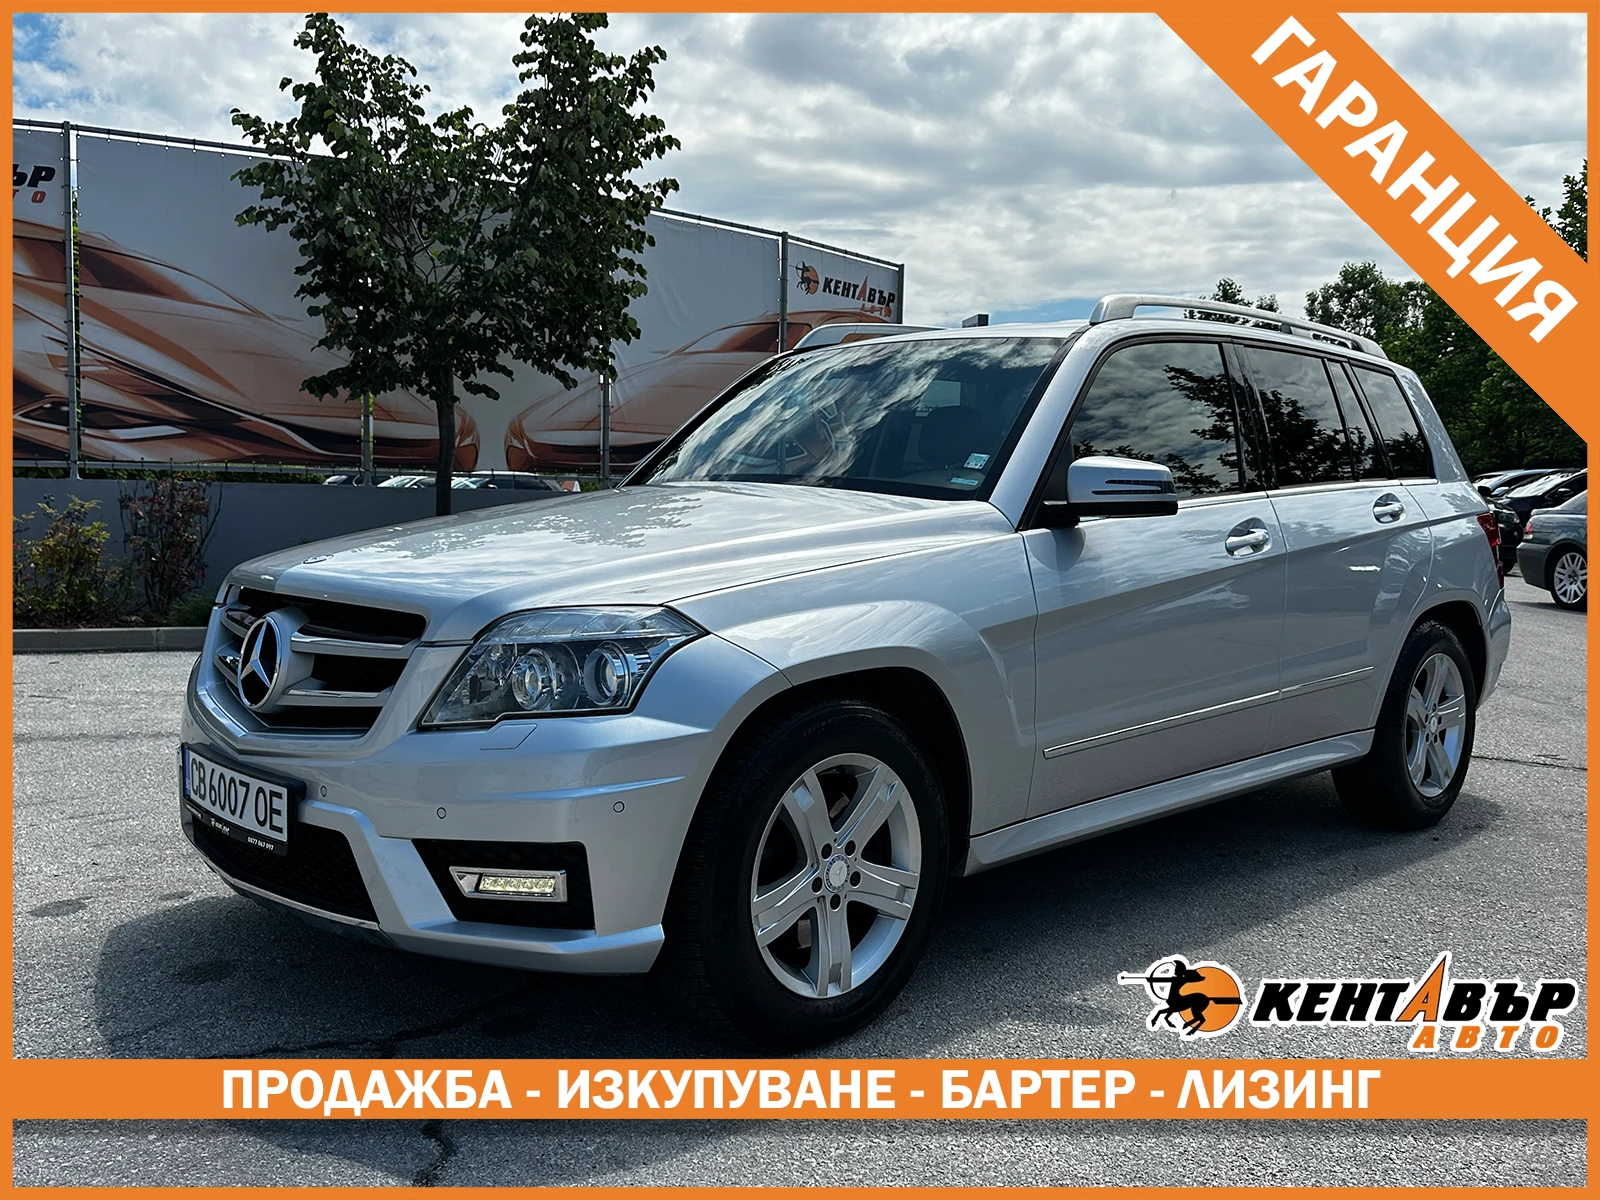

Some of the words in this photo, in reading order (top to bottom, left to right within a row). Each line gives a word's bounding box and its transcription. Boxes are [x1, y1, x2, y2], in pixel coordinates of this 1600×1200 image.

[822, 275, 896, 307] КЕНТАВЪР
[860, 303, 892, 318] АВТО
[209, 768, 250, 820] 6007
